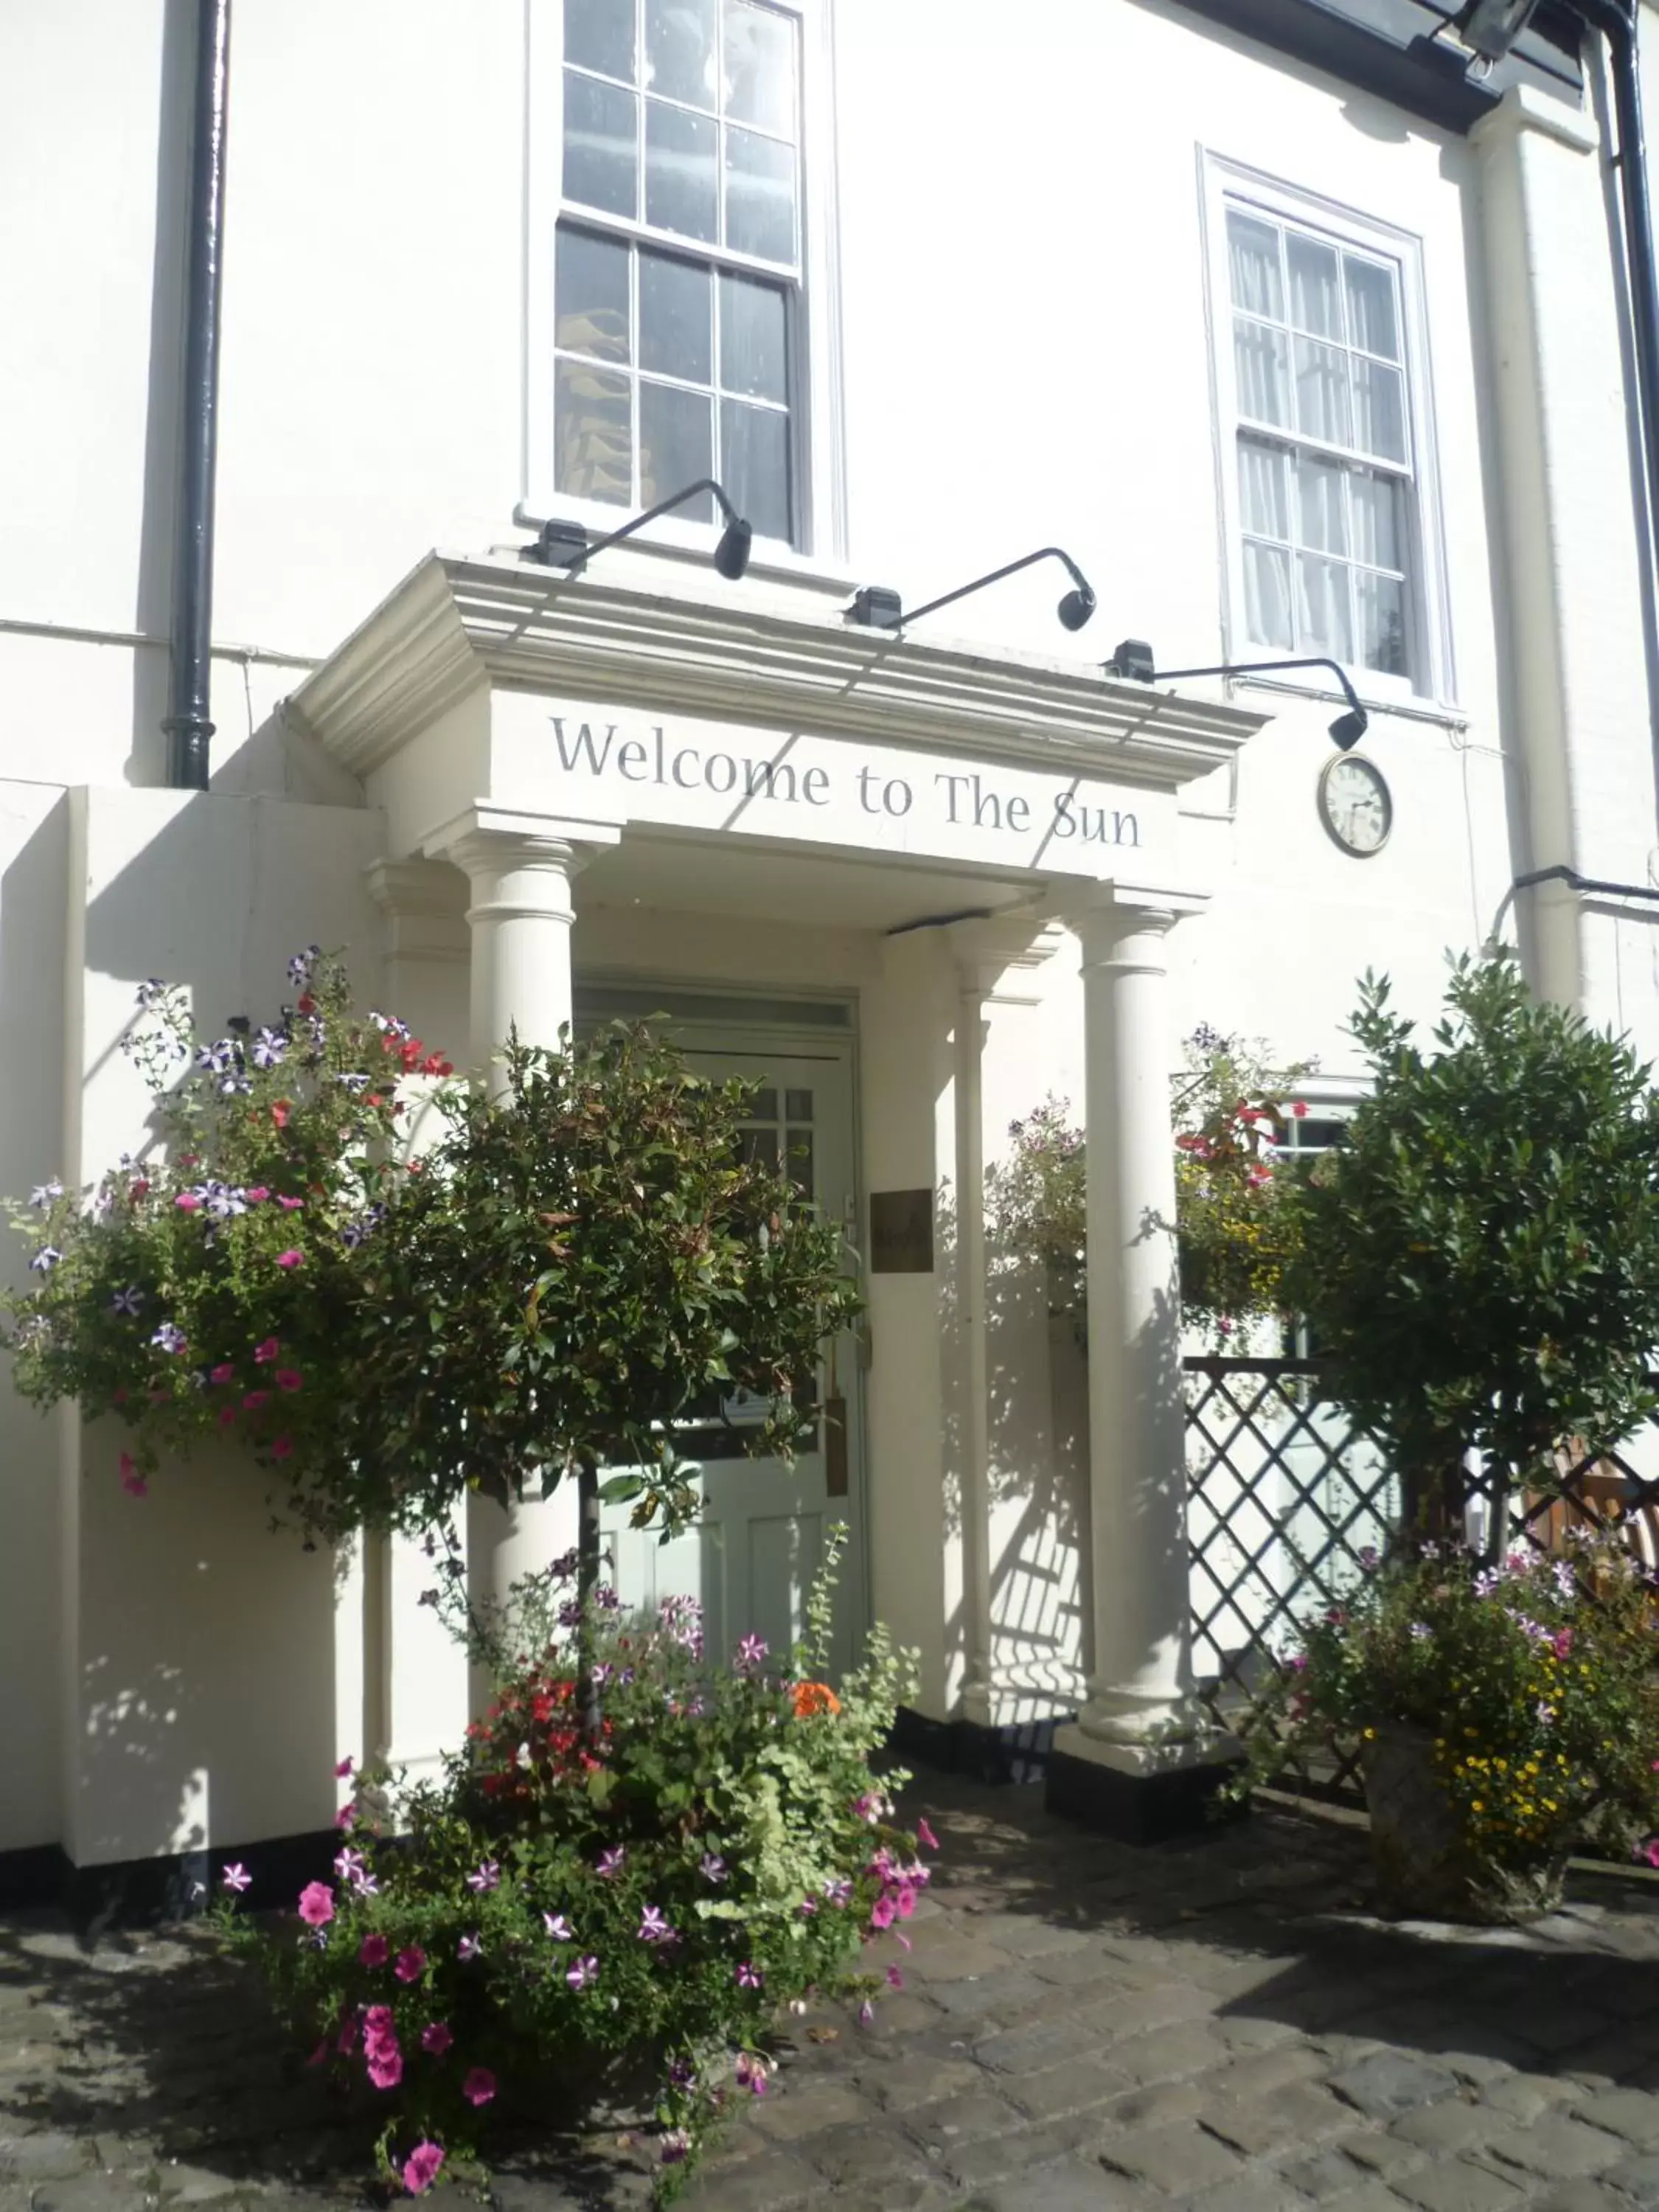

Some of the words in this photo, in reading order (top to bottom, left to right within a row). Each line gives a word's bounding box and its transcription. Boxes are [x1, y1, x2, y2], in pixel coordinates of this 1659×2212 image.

[549, 716, 830, 805] Welcome
[856, 765, 912, 815] to
[934, 773, 1031, 832] The
[1051, 793, 1142, 846] Sun
